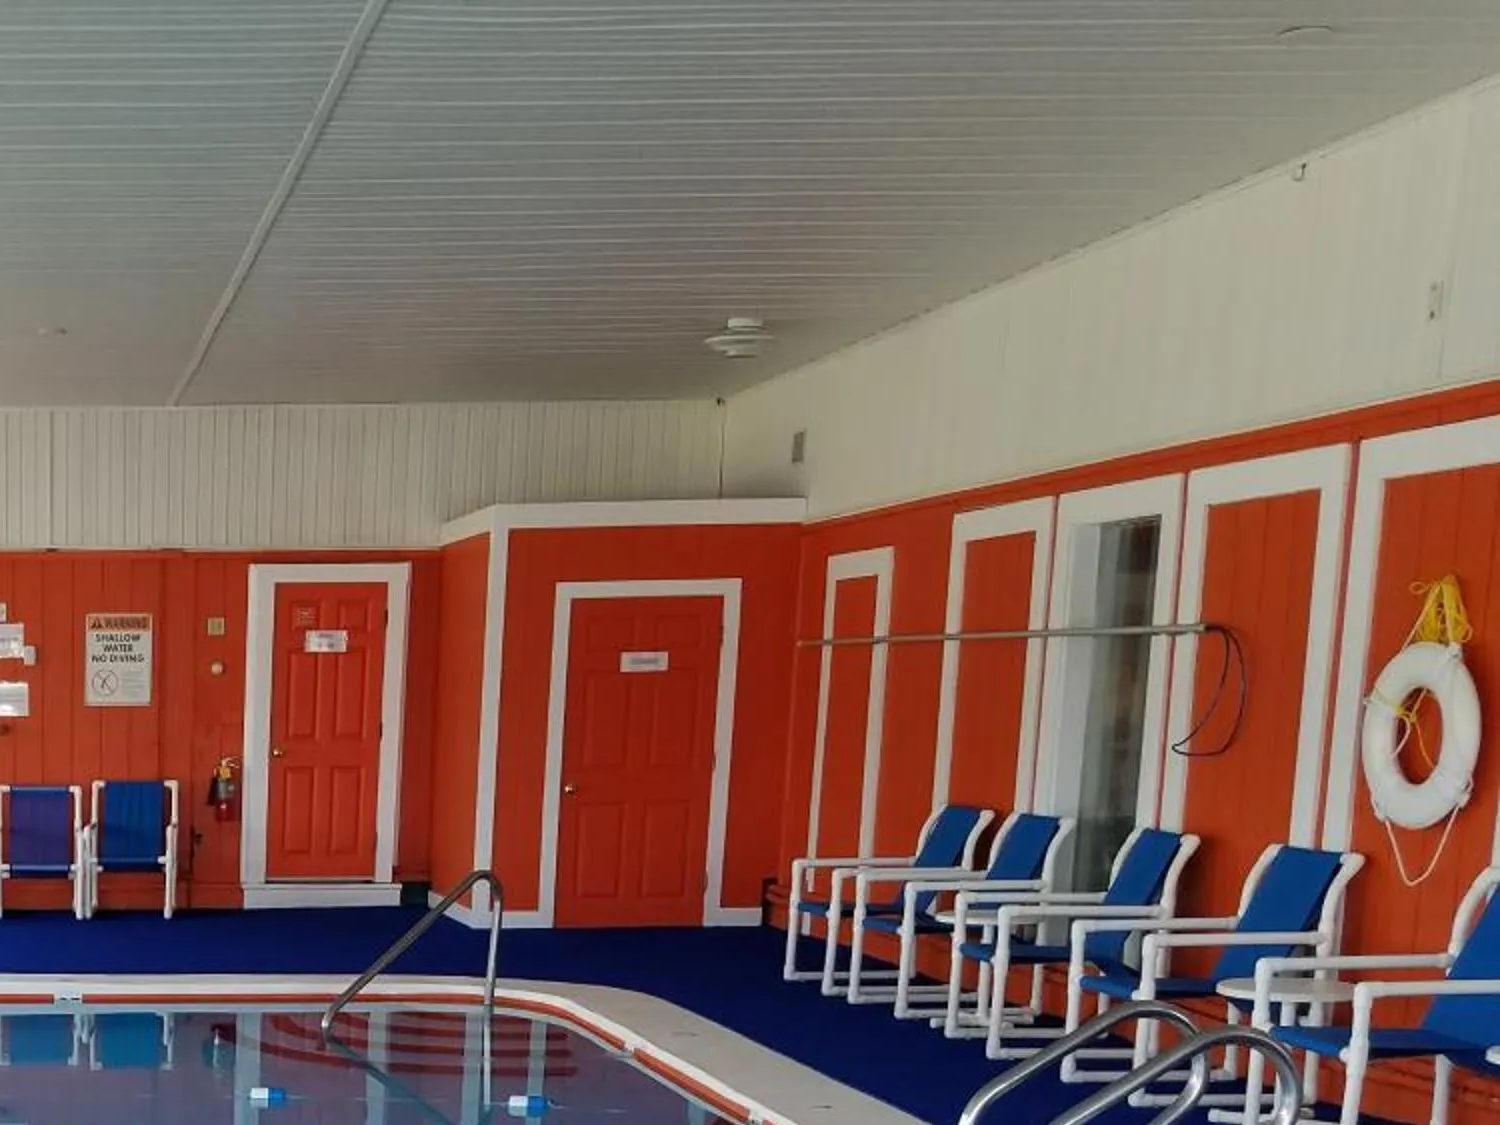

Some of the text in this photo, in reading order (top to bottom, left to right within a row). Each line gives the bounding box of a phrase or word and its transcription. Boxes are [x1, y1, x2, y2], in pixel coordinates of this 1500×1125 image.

[95, 634, 140, 642] SHALLOW
[102, 644, 133, 652] WATER
[91, 654, 145, 663] NO DIVING
